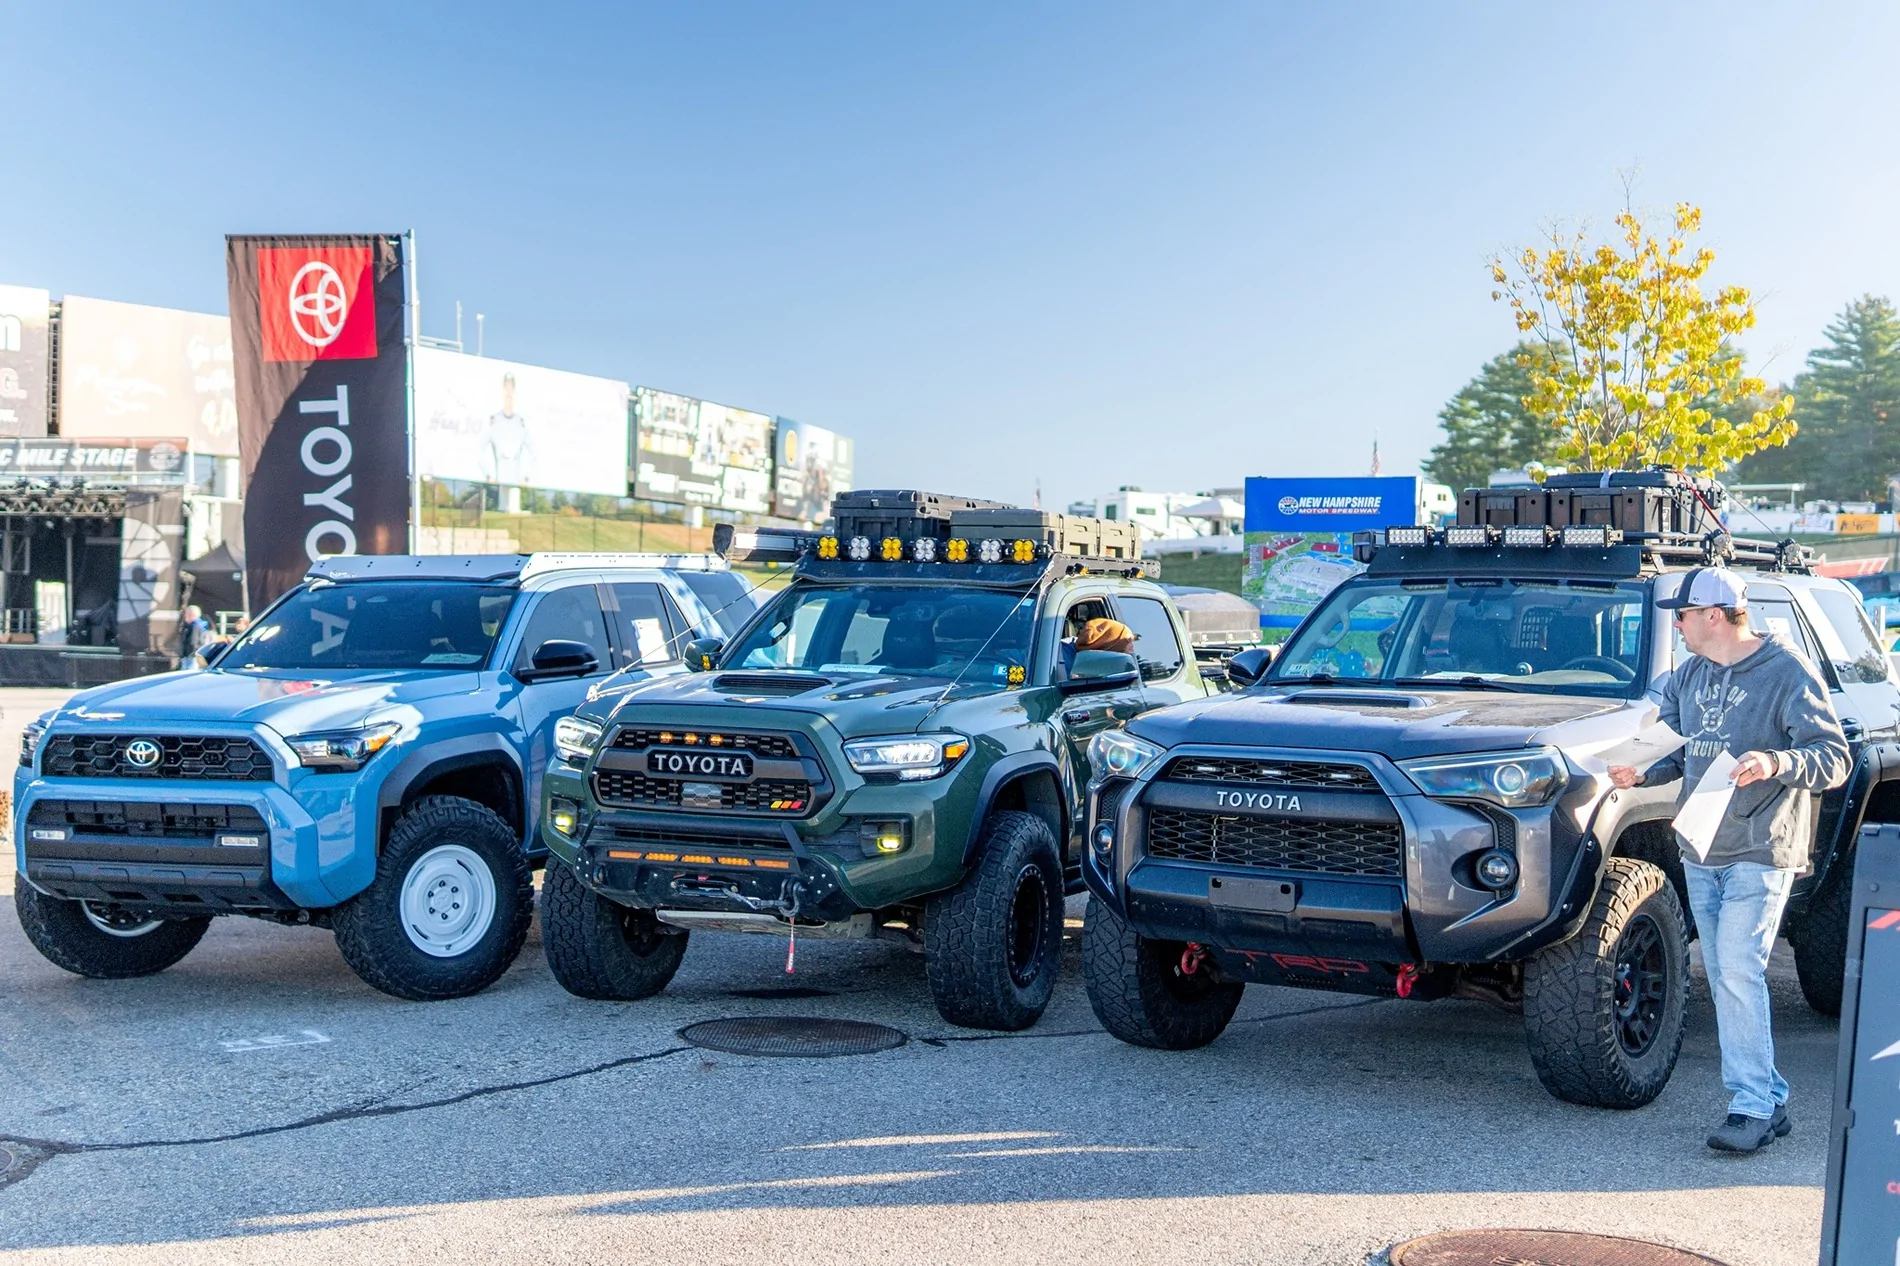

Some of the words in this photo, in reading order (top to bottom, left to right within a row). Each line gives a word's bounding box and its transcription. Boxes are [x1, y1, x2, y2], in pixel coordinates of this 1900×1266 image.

[16, 448, 68, 466] MILE
[70, 448, 139, 467] STAGE
[1299, 496, 1322, 507] NEW
[1322, 496, 1382, 508] HAMPSHIRE
[654, 753, 746, 775] TOYOTA
[1216, 790, 1302, 812] TOYOTA
[1225, 948, 1370, 973] TRD
